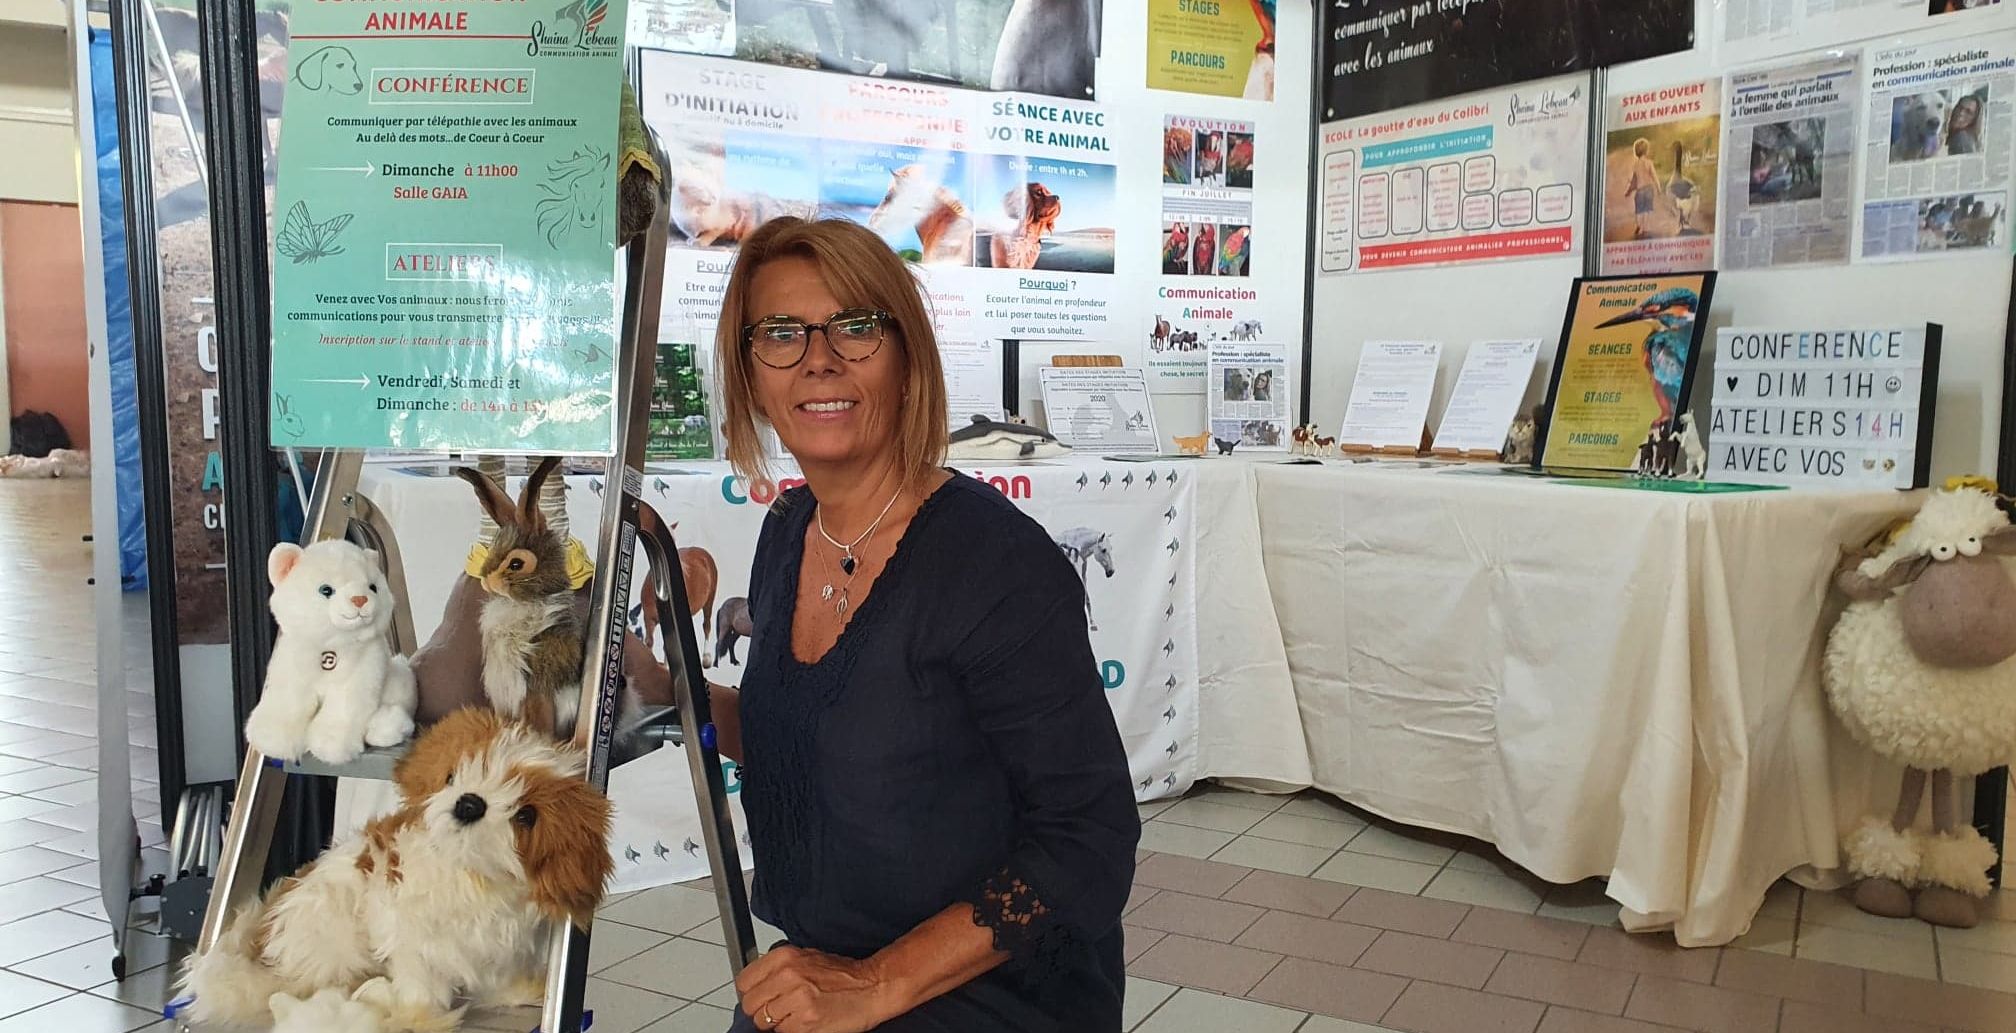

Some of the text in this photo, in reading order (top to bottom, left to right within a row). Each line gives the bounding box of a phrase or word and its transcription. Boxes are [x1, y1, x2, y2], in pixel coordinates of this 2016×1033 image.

[1179, 0, 1220, 16] STAGES
[364, 12, 468, 31] ANIMALE
[1334, 8, 1406, 40] communiquer
[1411, 1, 1432, 29] par
[1170, 50, 1225, 70] PARCOURS
[1333, 39, 1434, 77] avec les animaux
[1873, 50, 1989, 77] Profession spécialiste
[699, 68, 767, 91] STAGE
[1872, 57, 2015, 89] en communication animale
[377, 73, 529, 94] CONFÉRENCE
[1622, 83, 1706, 107] STAGE OUVERT
[1732, 96, 1743, 106] La
[1744, 91, 1779, 104] femme
[1780, 86, 1797, 100] qui
[1799, 80, 1832, 97] parlait
[664, 92, 799, 121] D'INITIATION
[992, 97, 1105, 127] SÉANCE AVEC
[1625, 101, 1701, 122] AUX ENFANTS
[1730, 92, 1840, 117] à l'oreille des animaux
[327, 115, 577, 129] Communiquer par télépathie avec les animaux
[744, 117, 784, 130] domicile
[1325, 103, 1489, 144] ECOLE La goutte d'eau du Colibri
[356, 133, 371, 143] Au
[373, 131, 397, 143] delà
[398, 132, 417, 143] des
[468, 133, 501, 143] Coeur
[503, 131, 510, 143] à
[512, 133, 545, 143] Coeur
[984, 126, 1044, 144] VORE
[1047, 131, 1110, 152] ANIMAL
[1365, 152, 1384, 160] POUR
[382, 163, 518, 177] Dimanche à 11h00
[394, 186, 468, 199] Salle GAIA
[393, 254, 496, 271] ATELIERS
[685, 282, 706, 292] Etre
[1019, 277, 1068, 291] Pourquoi
[1586, 282, 1658, 295] Communication
[315, 293, 481, 306] Venez avec Vos animaux nous
[986, 294, 1019, 304] Ecouter
[1021, 295, 1052, 305] l'animal
[1065, 297, 1107, 308] profondeur
[1158, 286, 1256, 300] Communication
[678, 297, 722, 306] commun
[1599, 298, 1637, 308] Animale
[287, 310, 378, 322] communications
[380, 313, 406, 324] pour
[408, 313, 434, 322] vous
[436, 313, 502, 323] transmettre
[984, 309, 1107, 322] et lui poser toutes les questions
[1182, 306, 1233, 320] Animale
[1010, 325, 1085, 336] que vous souhaitez.
[319, 333, 375, 347] Inscription
[380, 336, 397, 345] sur
[413, 334, 443, 346] stand
[1731, 331, 1902, 360] CONFERENCE
[377, 374, 521, 390] Vendredi, Samedi et
[1757, 372, 1873, 398] DIM 11H
[376, 397, 450, 411] Dimanche
[460, 398, 477, 412] de
[1583, 391, 1622, 403] STAGES
[1712, 408, 1903, 438] ATELIERS 14H
[1568, 433, 1619, 445] PARCOURS
[1724, 445, 1846, 476] AVEC VOS
